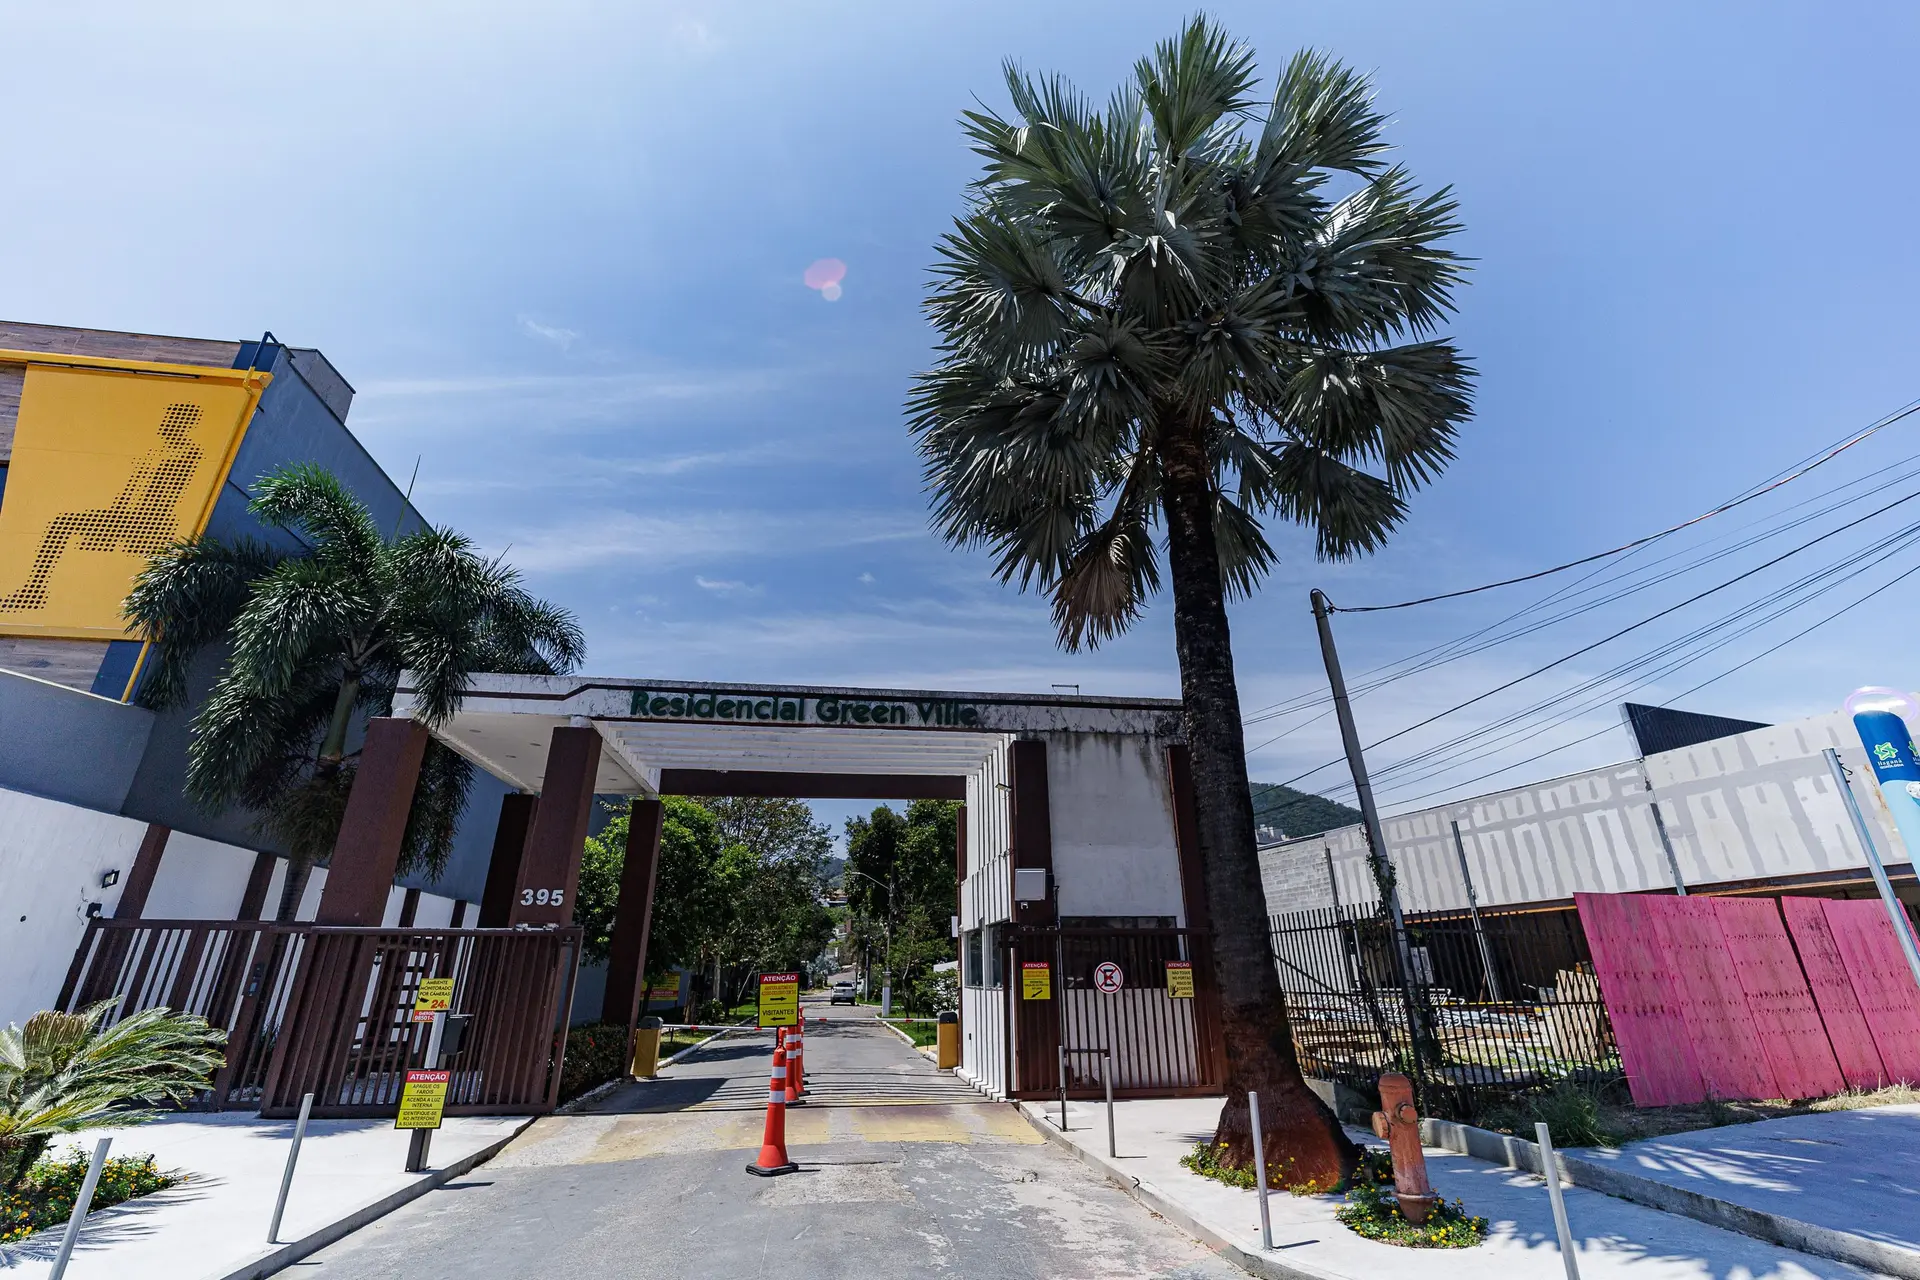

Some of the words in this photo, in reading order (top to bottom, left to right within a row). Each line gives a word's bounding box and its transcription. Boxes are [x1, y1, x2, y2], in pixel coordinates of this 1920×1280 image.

[630, 690, 806, 721] Residencial
[816, 696, 906, 724] Green
[916, 700, 978, 725] Ville
[520, 888, 564, 907] 395
[410, 1073, 446, 1081] ATENÇÃO
